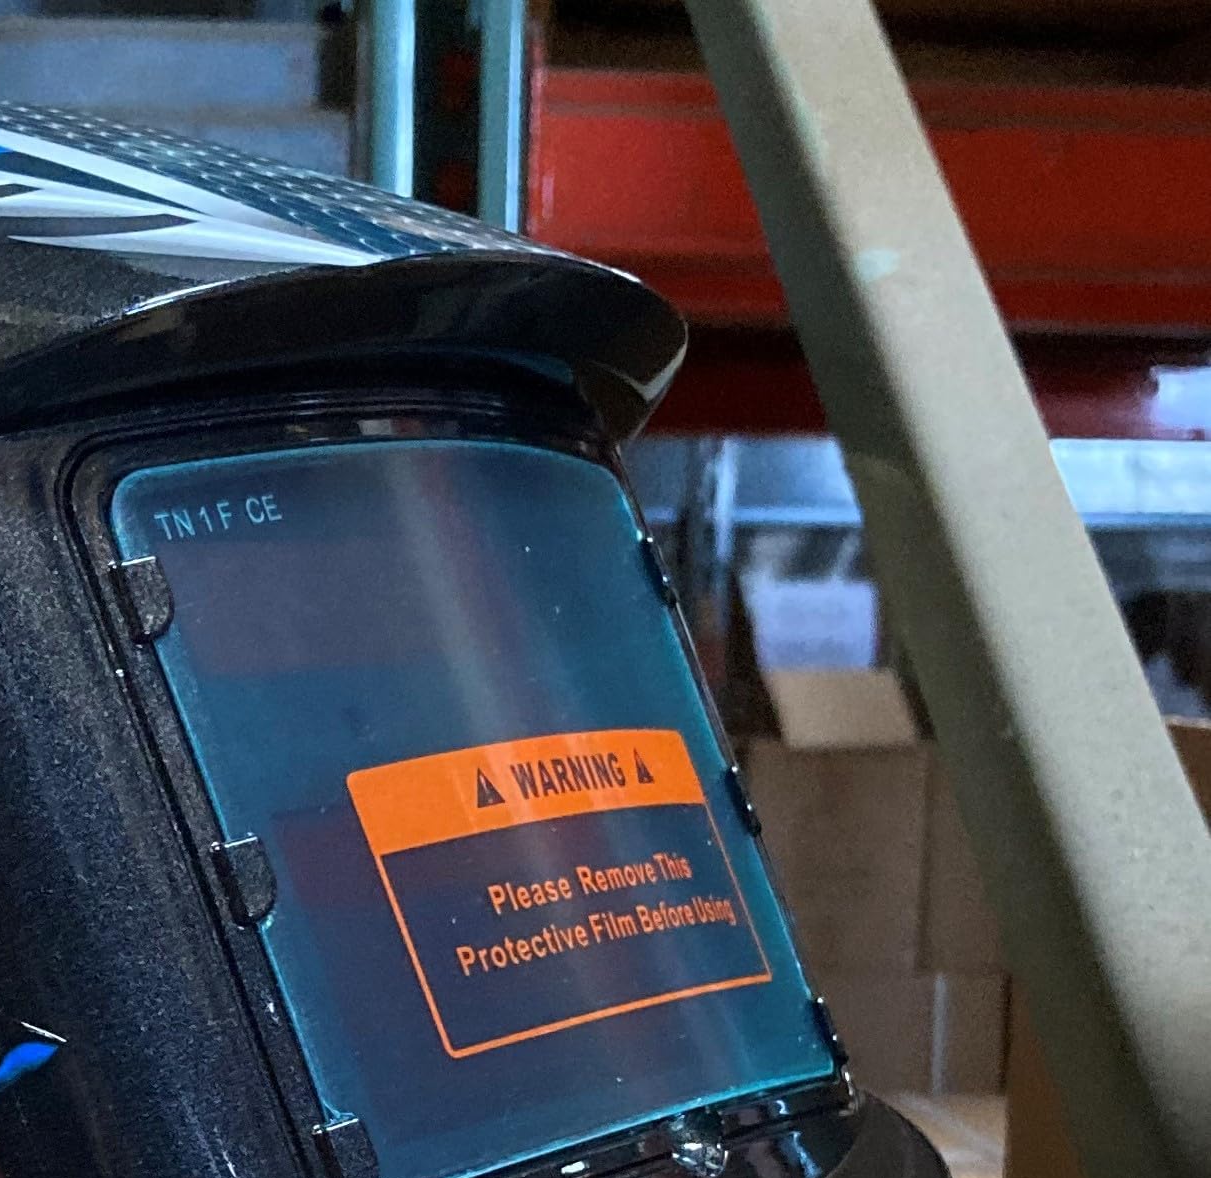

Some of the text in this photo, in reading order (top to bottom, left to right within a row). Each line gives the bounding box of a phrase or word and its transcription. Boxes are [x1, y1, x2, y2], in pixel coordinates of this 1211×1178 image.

[245, 494, 282, 524] CE
[510, 752, 626, 799] WARNING
[487, 852, 692, 915] Please Remove This
[456, 897, 738, 977] Protective Film Before Using
